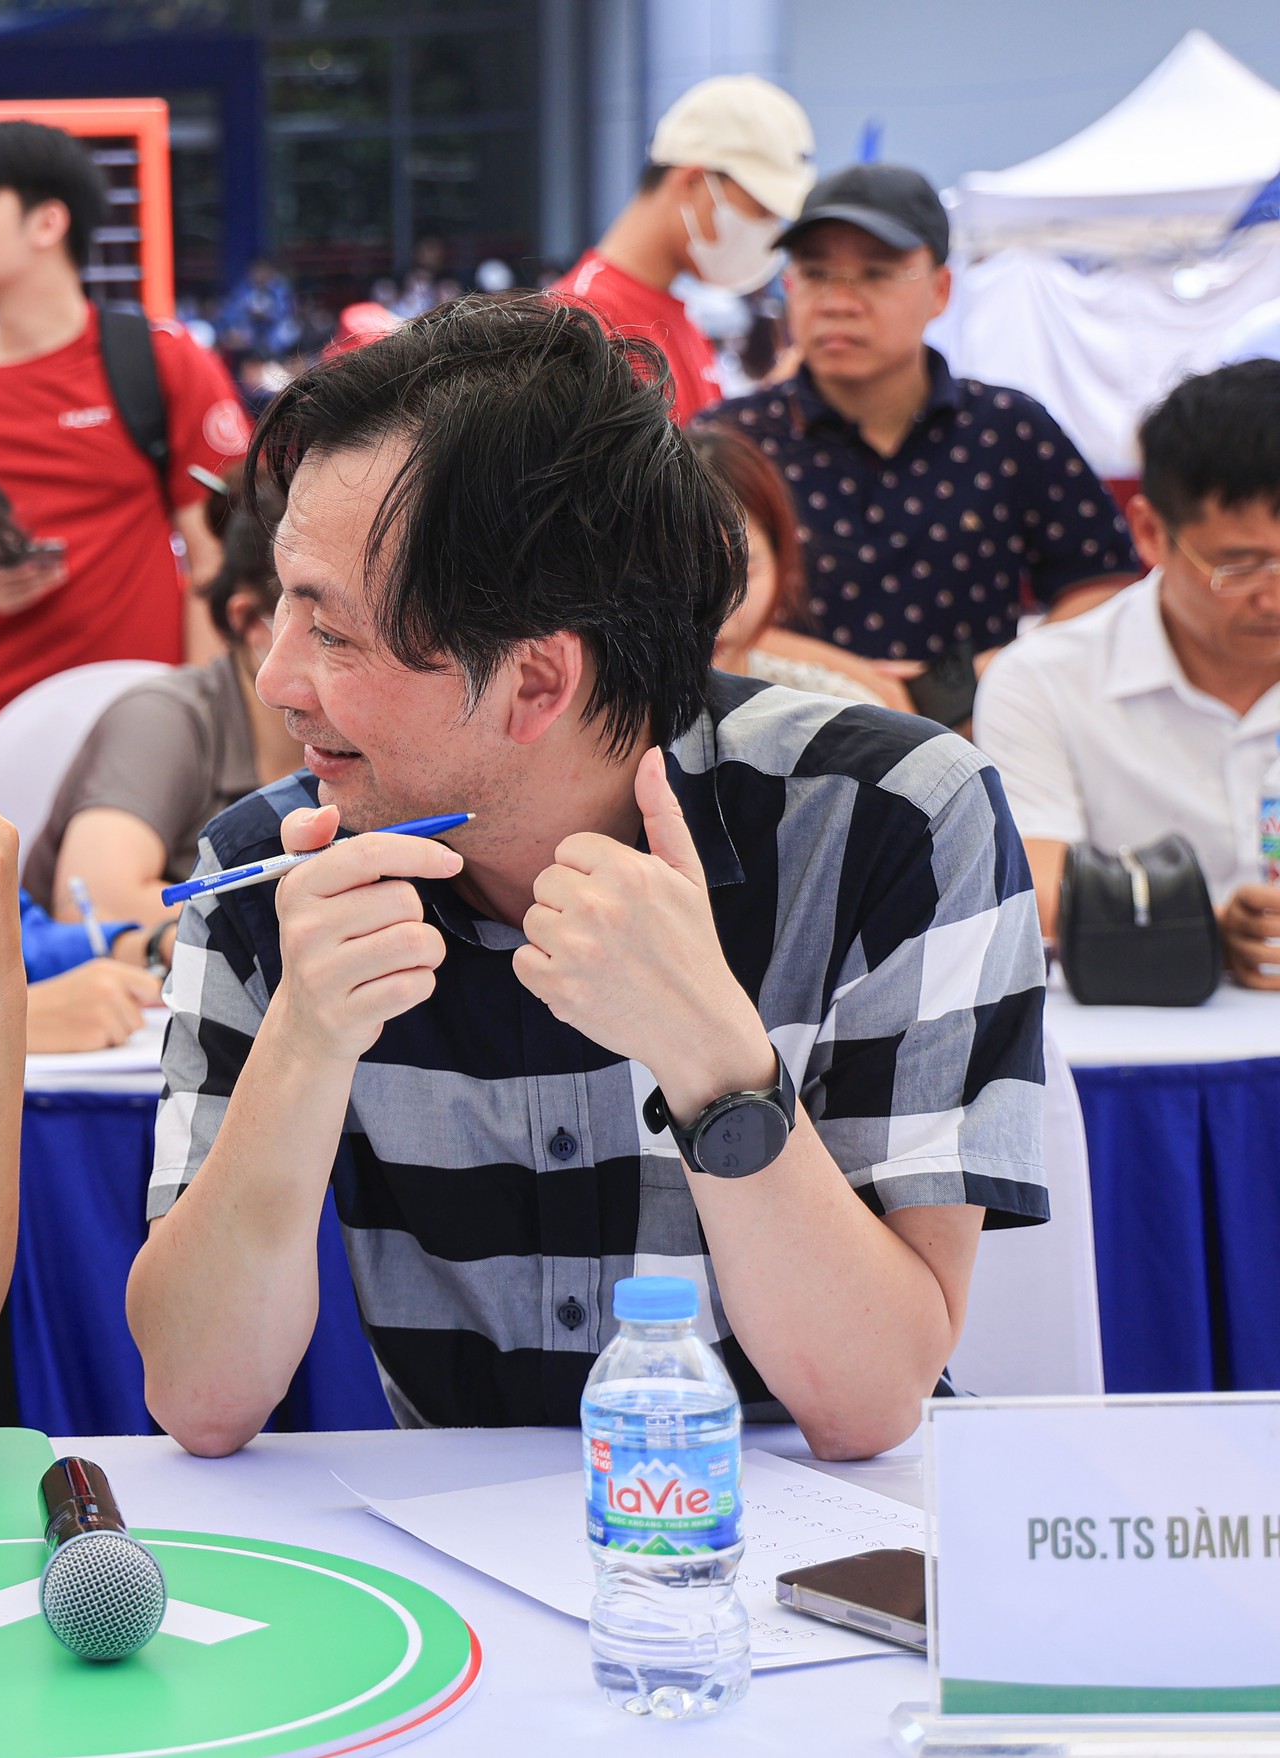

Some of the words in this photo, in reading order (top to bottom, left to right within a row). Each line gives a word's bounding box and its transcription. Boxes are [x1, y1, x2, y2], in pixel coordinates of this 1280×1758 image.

[607, 1477, 710, 1515] laVie
[1027, 1516, 1155, 1560] PGS.TS
[1165, 1506, 1250, 1559] ĐÀM
